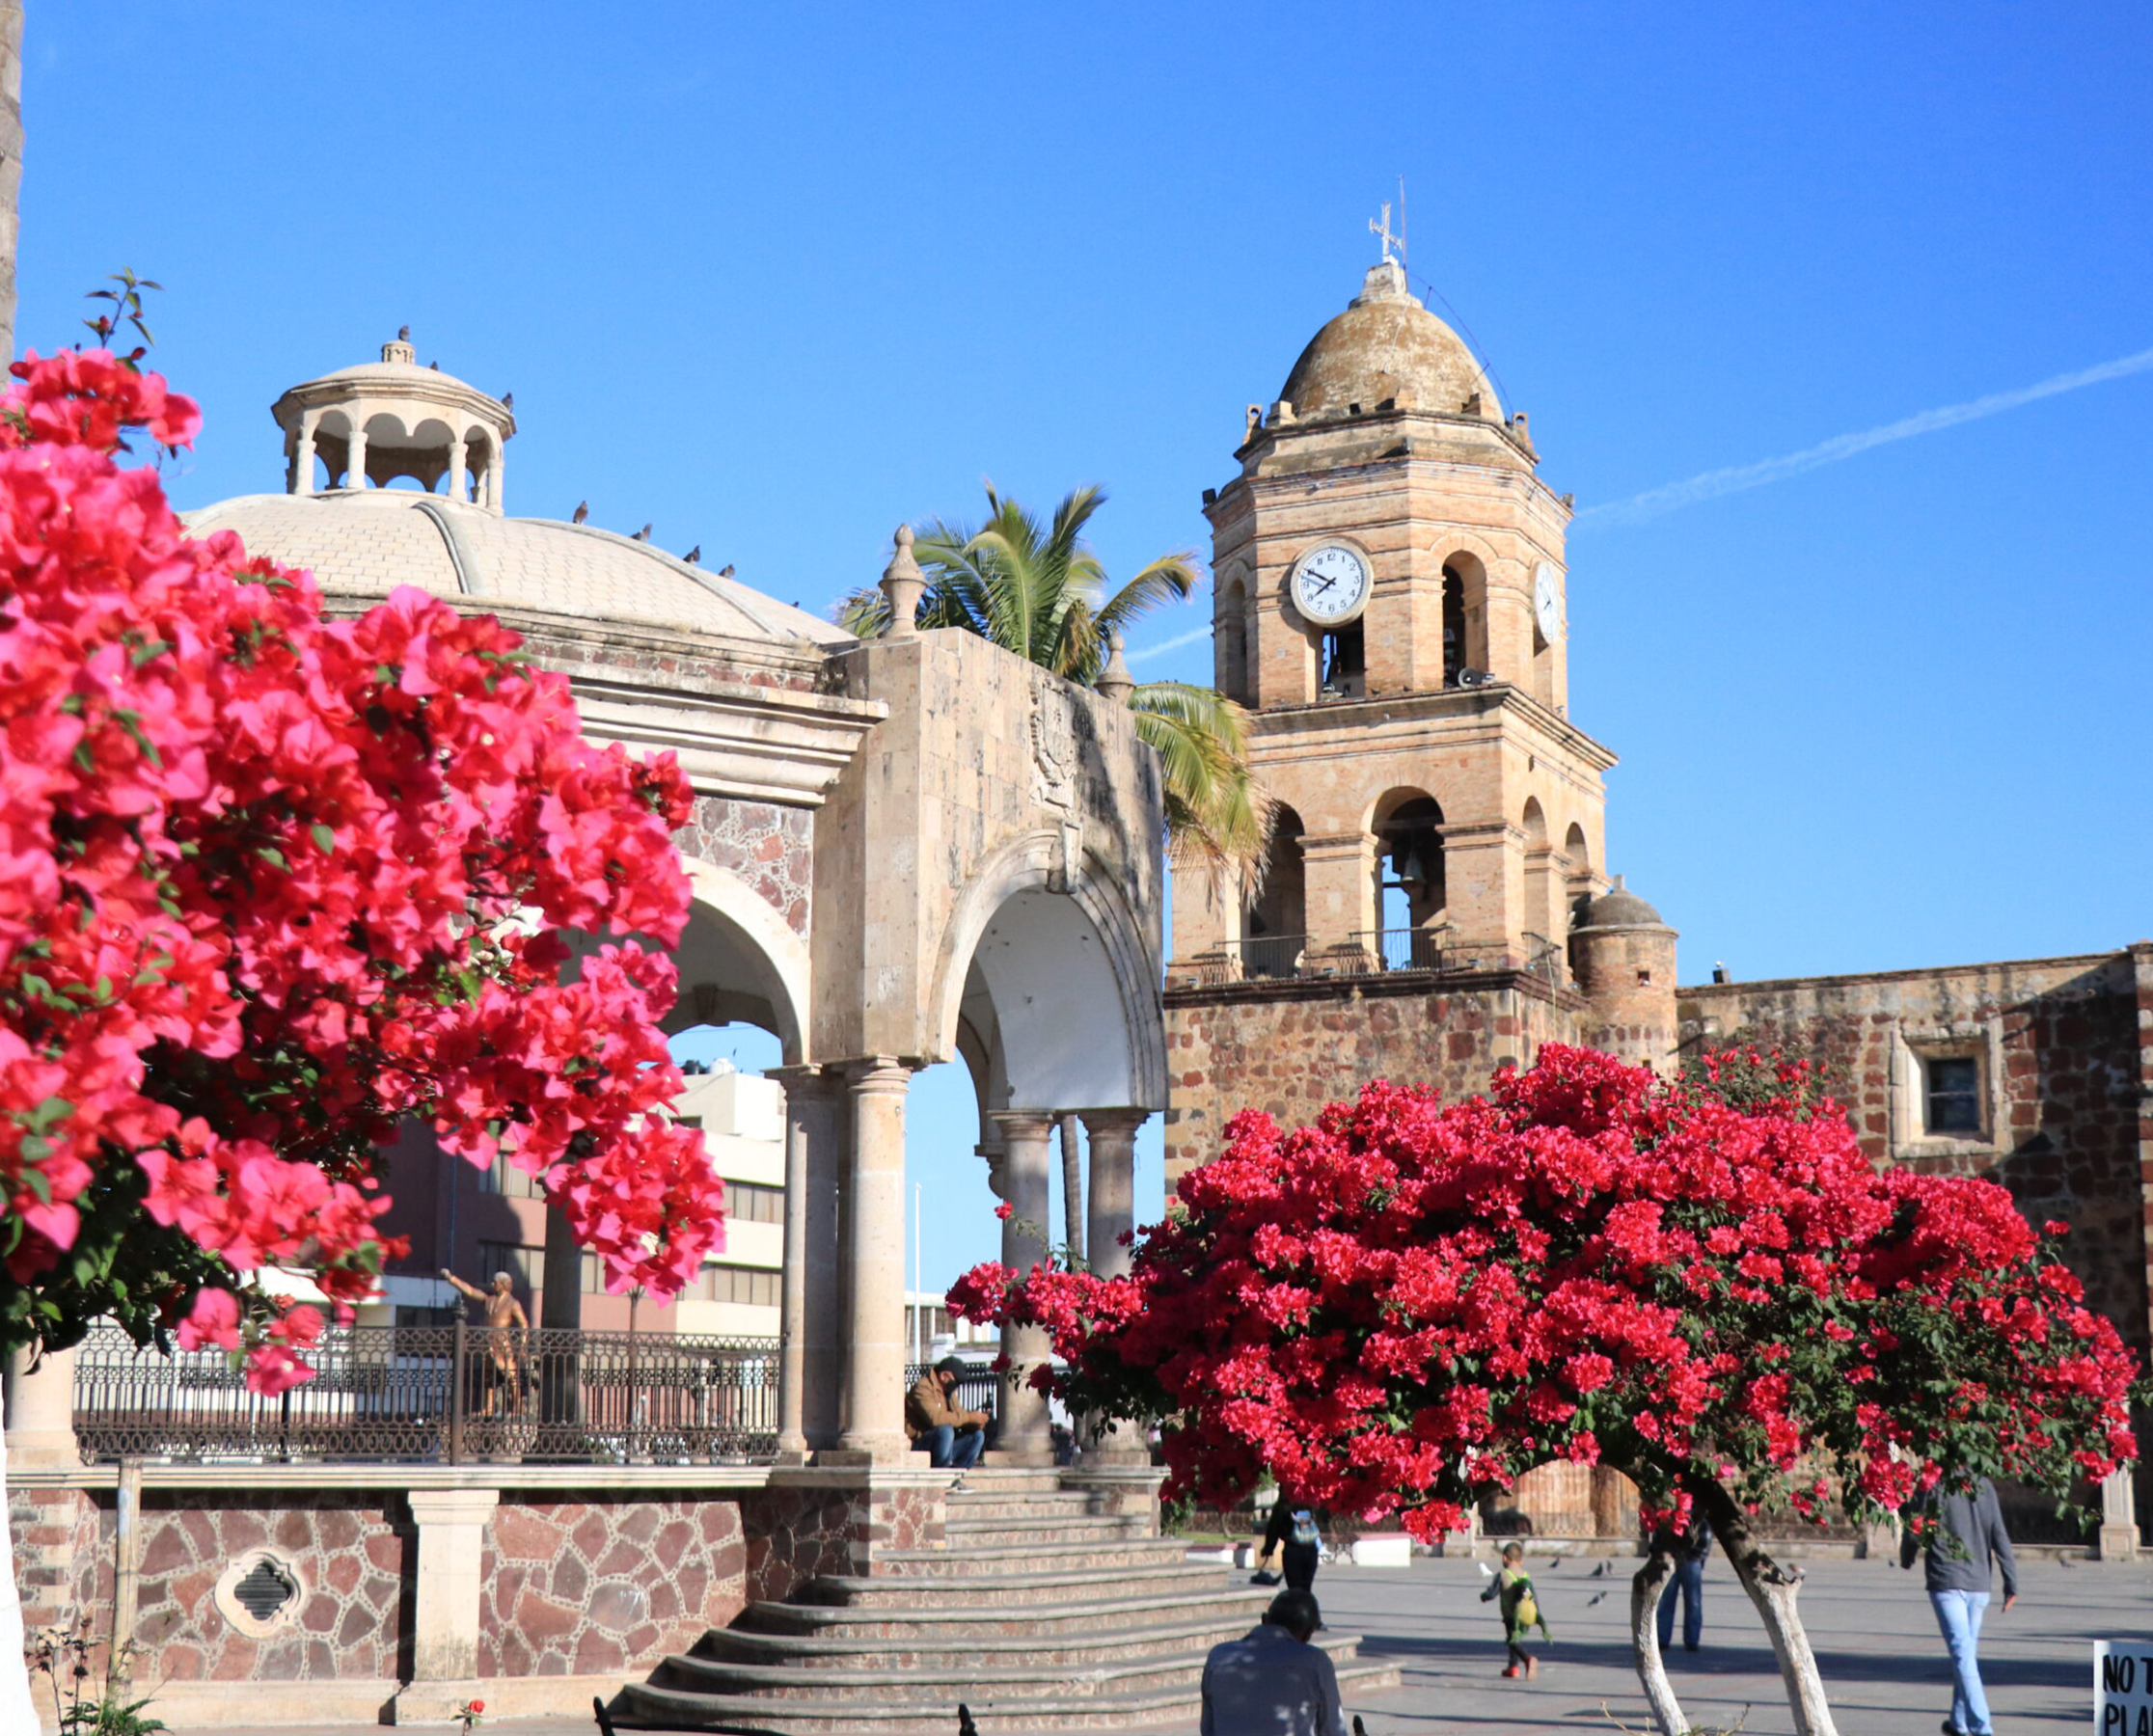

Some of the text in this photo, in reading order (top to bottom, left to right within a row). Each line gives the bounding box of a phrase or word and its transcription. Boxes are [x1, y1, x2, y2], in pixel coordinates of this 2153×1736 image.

[1327, 553, 1336, 561] 12
[1307, 593, 1314, 602] 8
[1317, 601, 1323, 610] 7
[1328, 604, 1335, 612] 6
[1340, 599, 1347, 608] 5
[2103, 1654, 2135, 1694] NO
[2104, 1703, 2153, 1736] PLA
